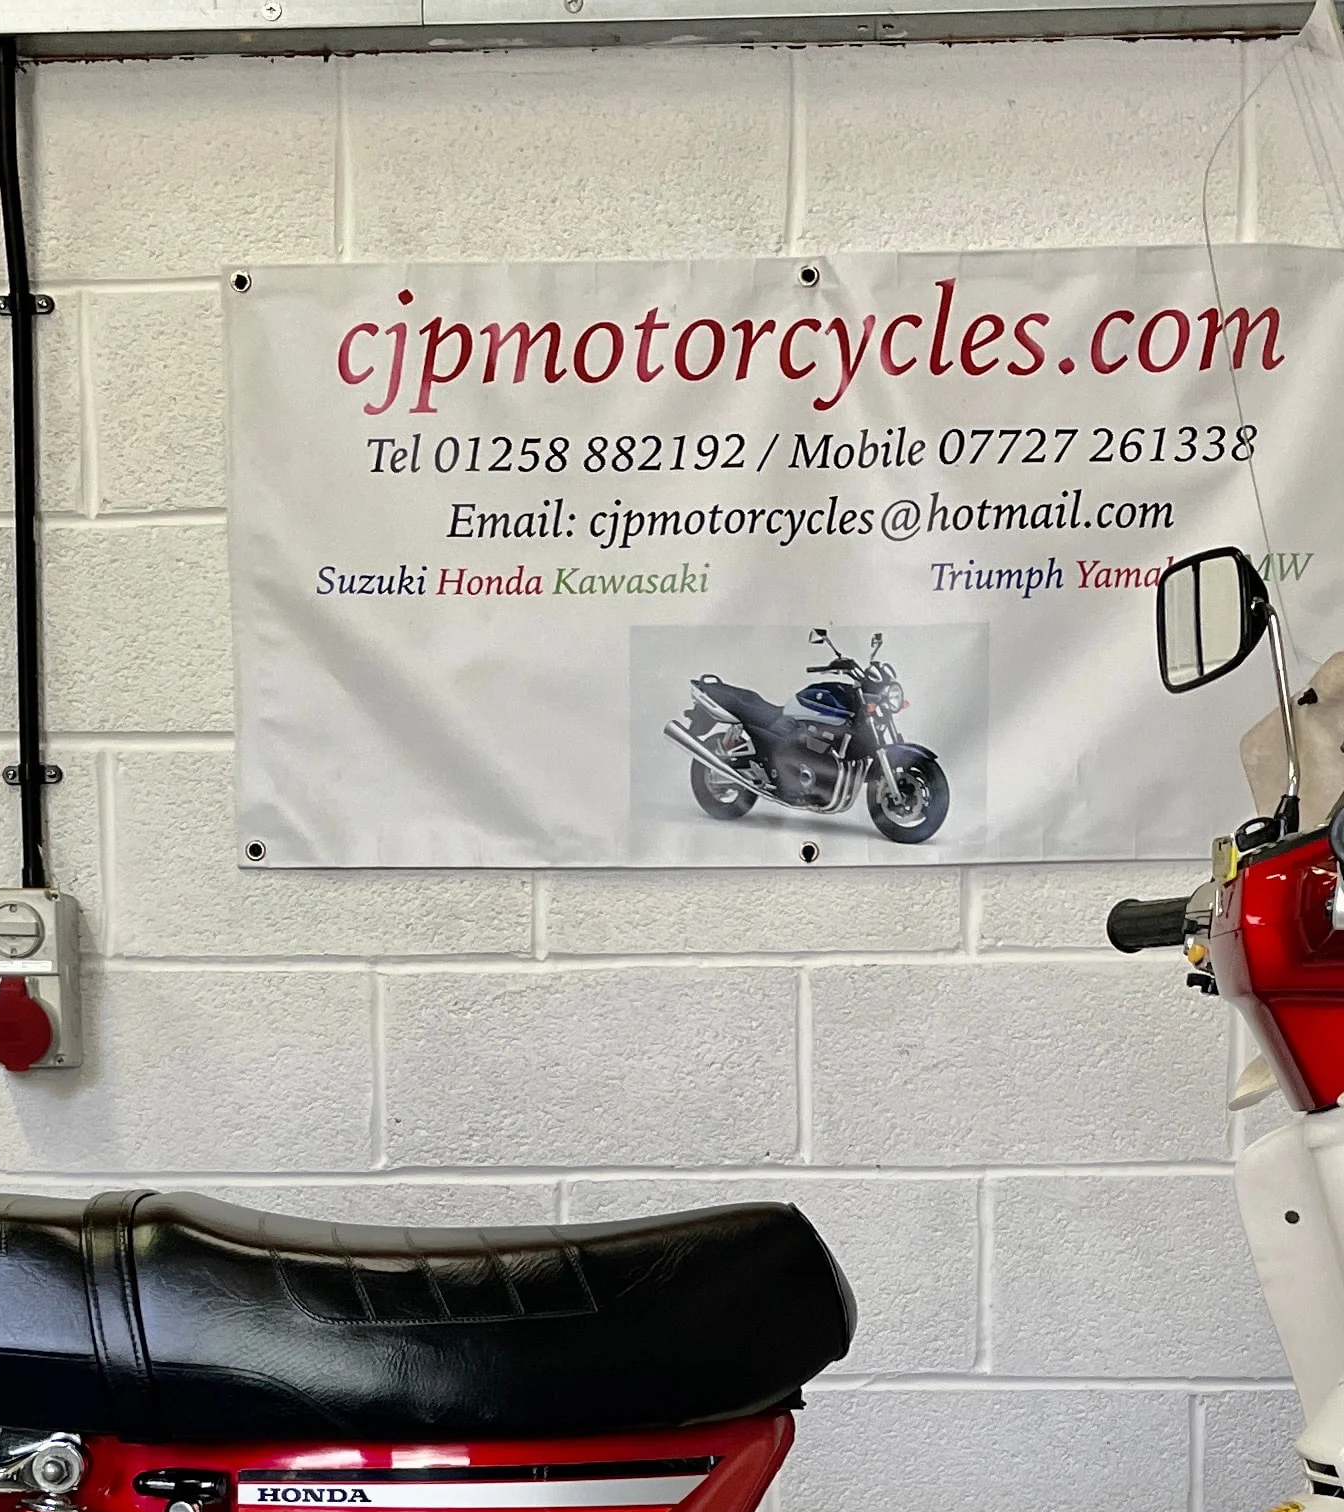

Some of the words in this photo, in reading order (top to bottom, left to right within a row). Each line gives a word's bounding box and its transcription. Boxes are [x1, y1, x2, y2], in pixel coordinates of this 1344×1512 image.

[337, 278, 1286, 415] cjpmotorcycles.com
[366, 433, 421, 474] Tel
[434, 435, 569, 474] 01258
[583, 433, 746, 473] 882192
[756, 432, 780, 473] /
[787, 426, 926, 470] Mobile
[938, 427, 1078, 466] 07727
[1088, 424, 1259, 464] 261338
[446, 497, 577, 539] Email:
[589, 489, 1175, 550] cjpmotorcycles@hotmail.com
[315, 564, 428, 596] Suzuki
[435, 564, 544, 597] Honda
[551, 561, 711, 596] Kawasaki
[930, 556, 1064, 599] Triumph
[1076, 555, 1174, 589] Yama
[1244, 552, 1315, 582] MW
[257, 1487, 372, 1503] HONDA
